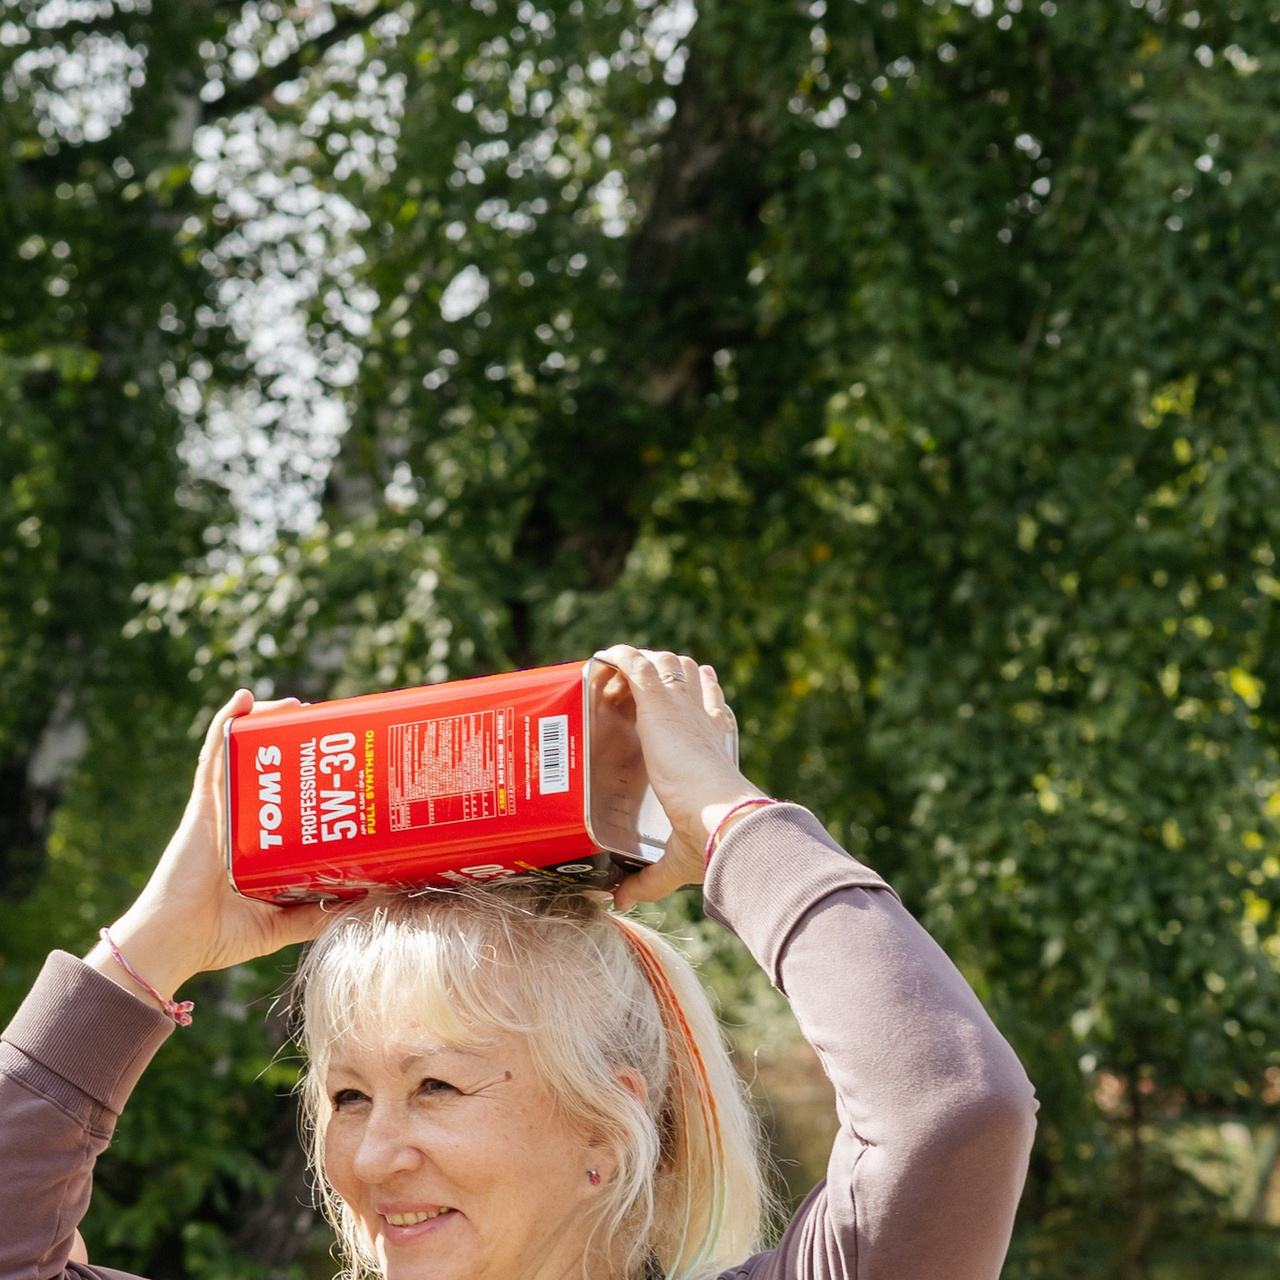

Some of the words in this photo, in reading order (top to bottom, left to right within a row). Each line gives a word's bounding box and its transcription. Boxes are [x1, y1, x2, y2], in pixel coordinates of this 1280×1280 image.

[256, 744, 282, 850] TOM'S
[301, 737, 319, 845] PROFESSIONAL
[320, 731, 356, 843] 5W-30
[365, 730, 374, 799] SYNTHETIC
[366, 803, 375, 834] FULL
